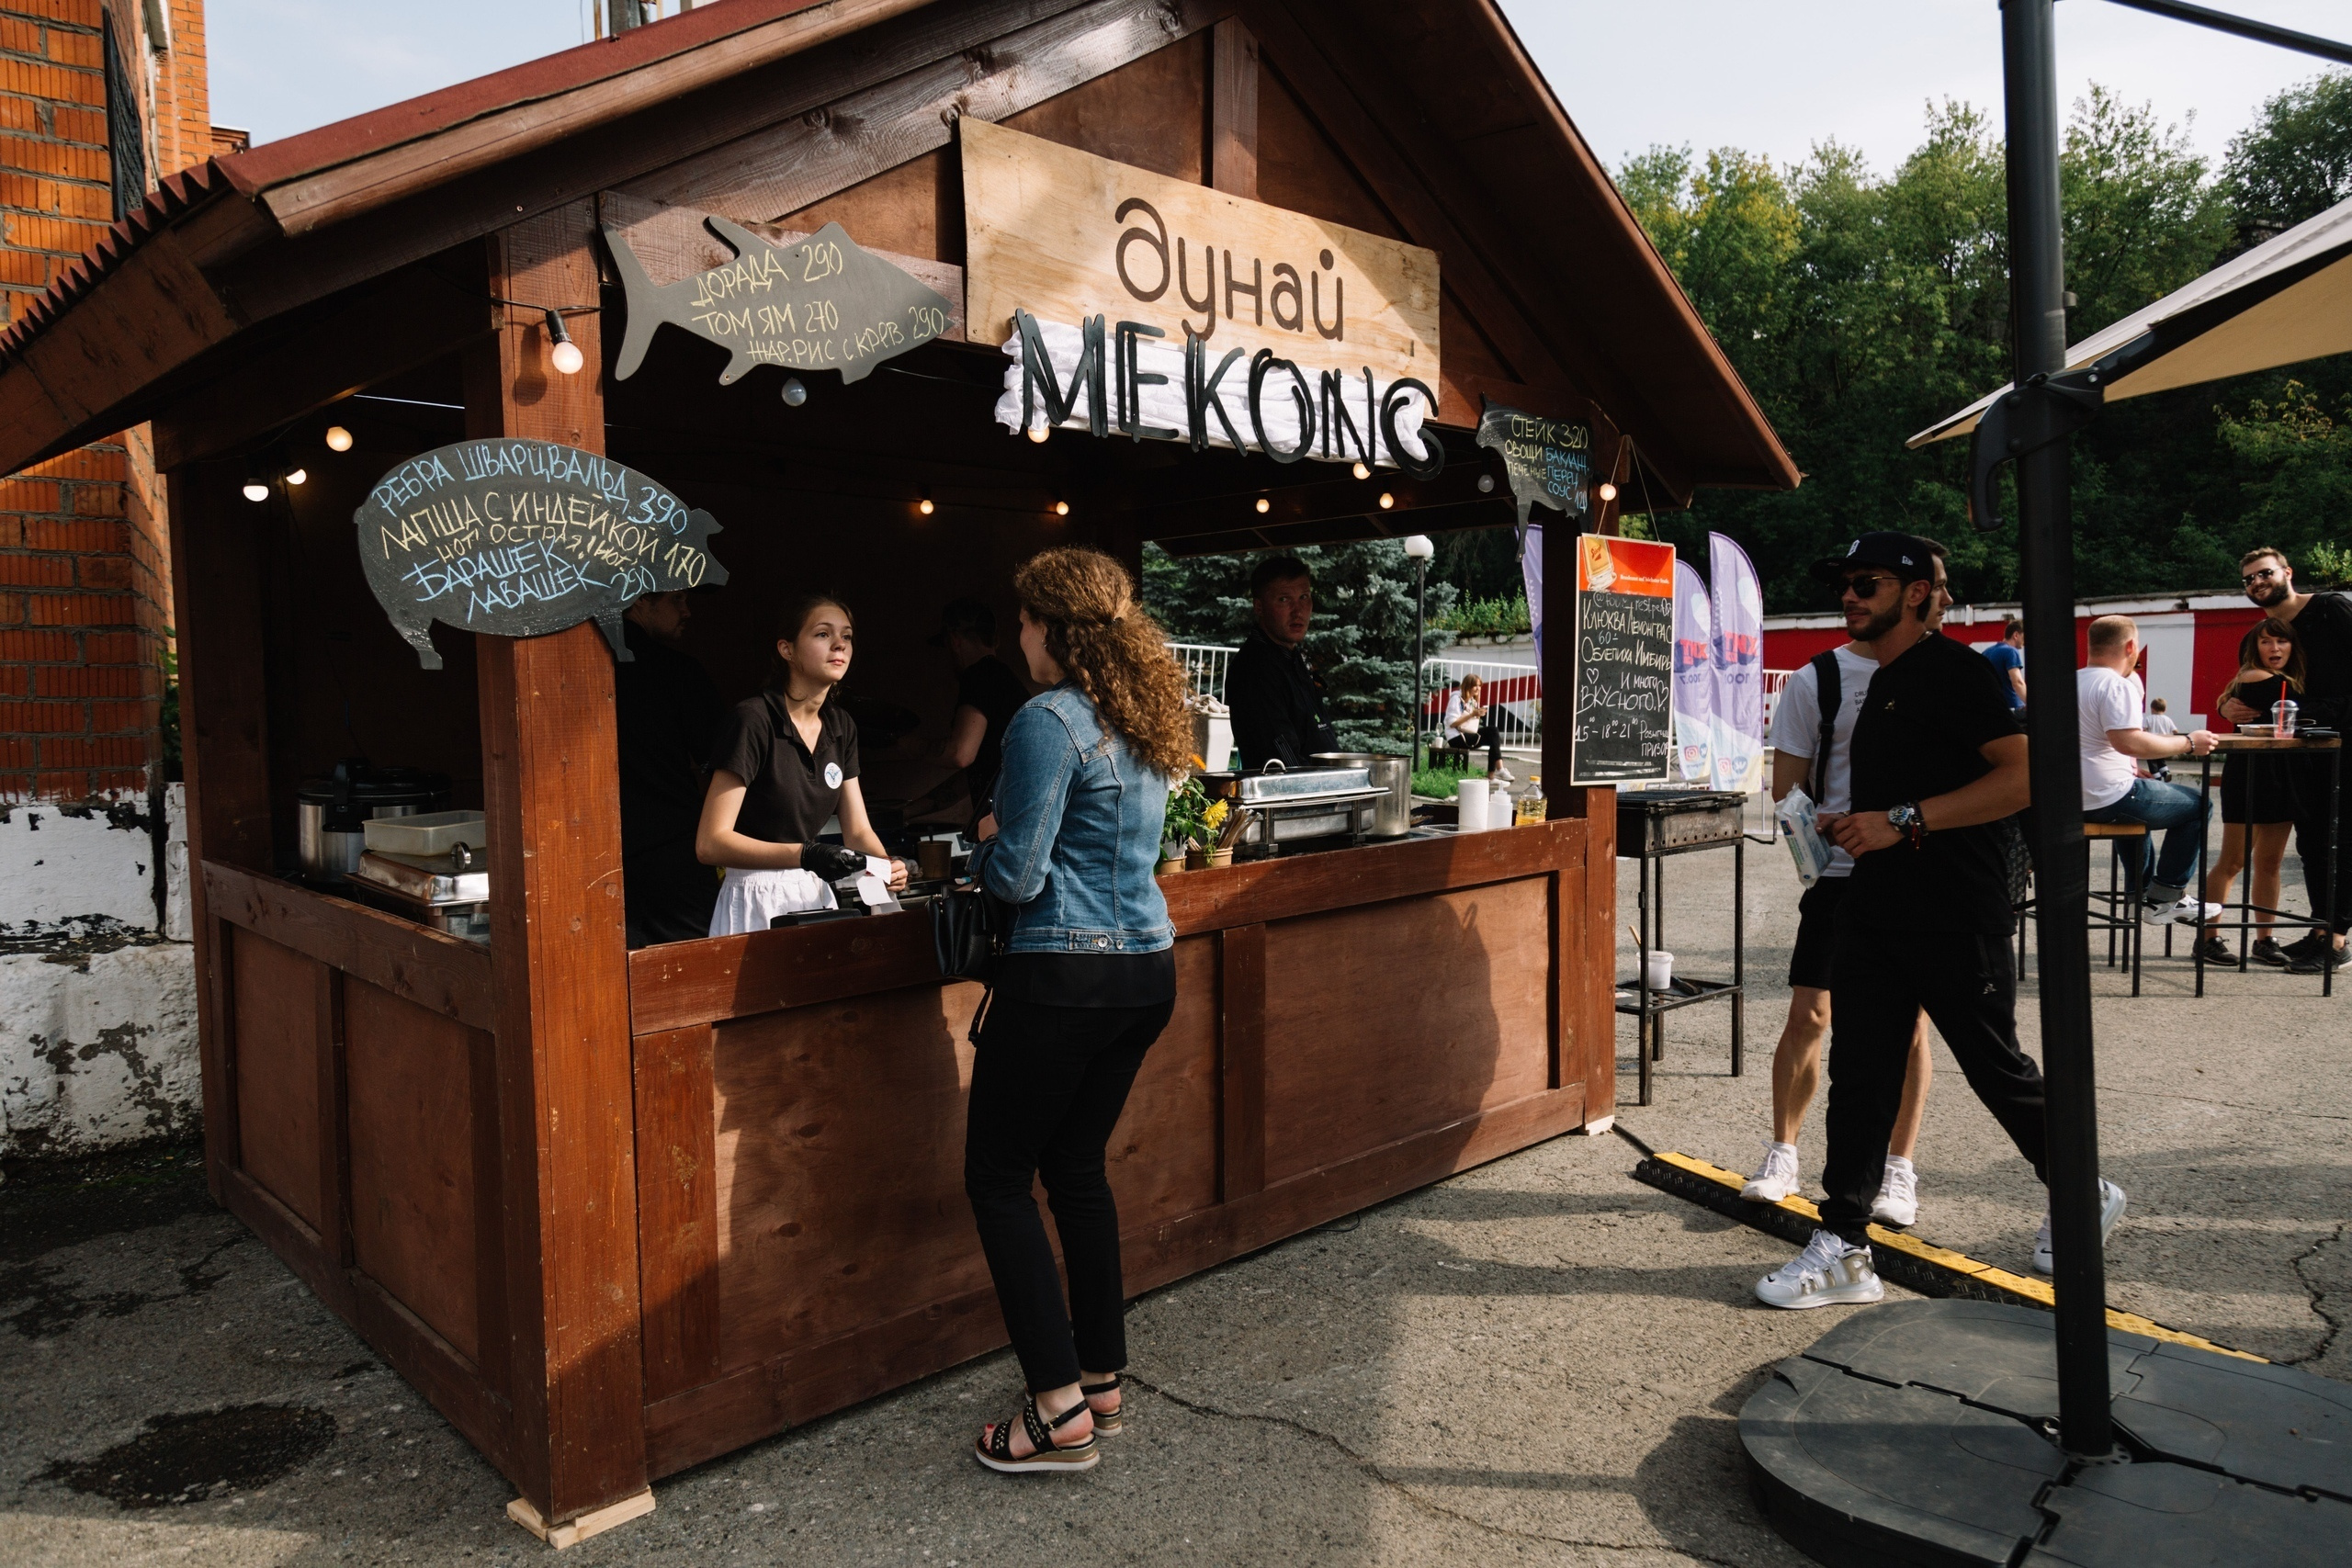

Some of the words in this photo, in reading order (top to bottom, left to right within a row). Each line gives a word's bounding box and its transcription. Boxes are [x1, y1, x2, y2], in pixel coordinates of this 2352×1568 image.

[690, 249, 789, 307] ДОРАДА
[802, 242, 843, 282] 290
[1114, 197, 1343, 343] дунай
[692, 307, 755, 336] ТОМ
[758, 302, 797, 335] ЯМ
[805, 300, 839, 333] 270
[909, 306, 944, 339] 290
[1505, 439, 1543, 464] ОВОЩИ
[1511, 414, 1555, 444] СТЕЙК
[1559, 424, 1589, 449] 320
[371, 455, 455, 517] РЕБРА
[456, 444, 630, 514] ШВАРЦВАЛЬД
[627, 486, 687, 536] 390
[1548, 481, 1572, 501] СОУС
[380, 495, 484, 559] ЛАПША
[484, 491, 503, 522] С
[510, 491, 660, 563] ИНДЕЙКОЙ
[663, 542, 707, 588] 170
[401, 536, 573, 602] БАРАШЕК
[468, 561, 611, 624] ЛАВАШЕК
[610, 566, 655, 602] 290
[1621, 671, 1630, 690] И
